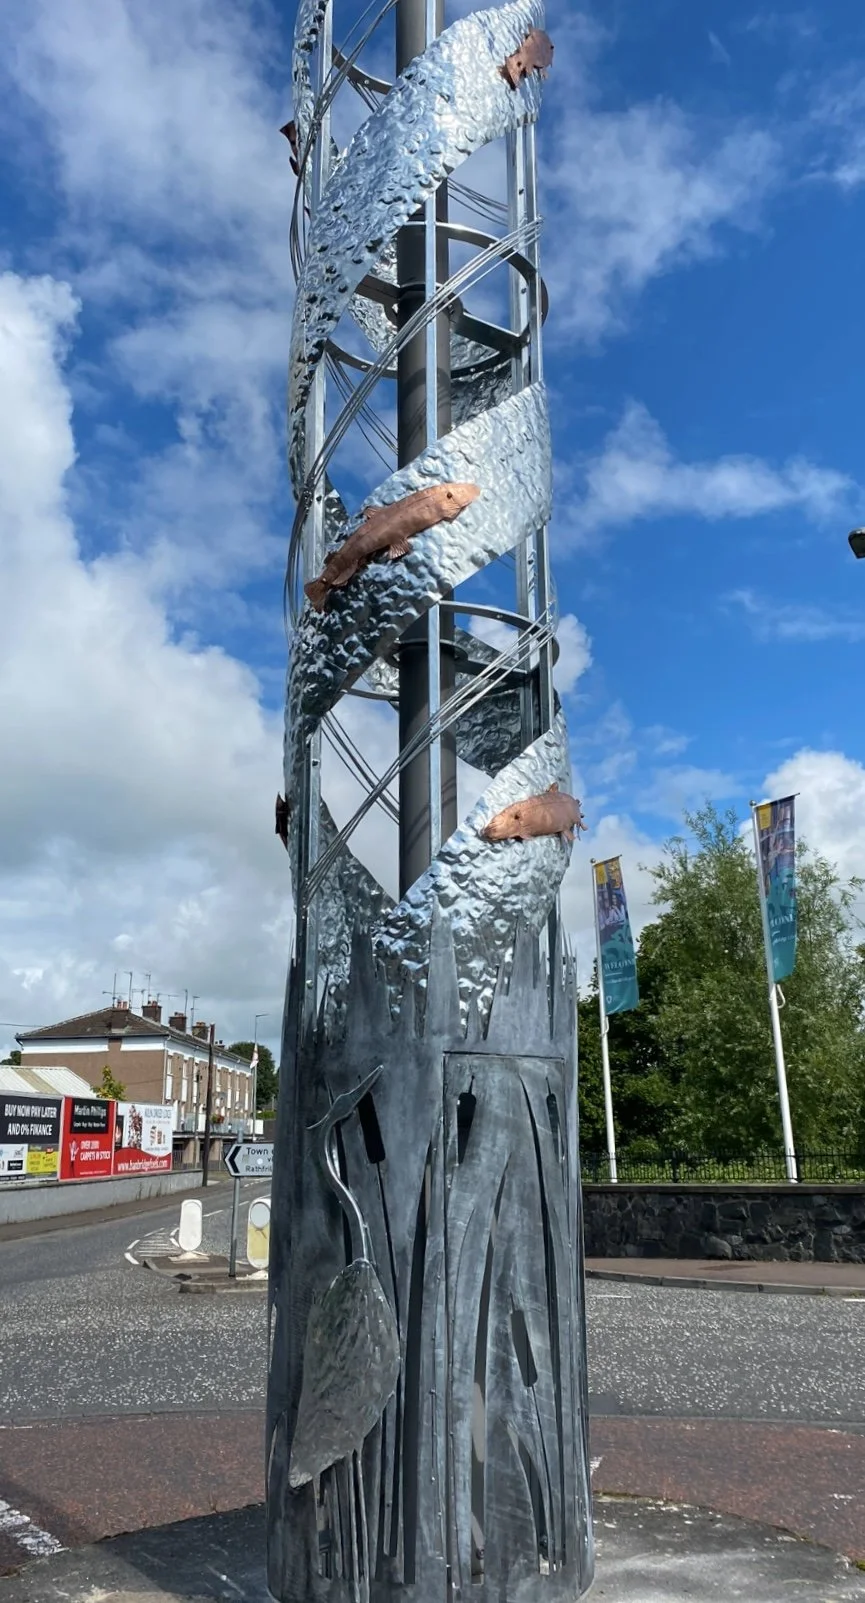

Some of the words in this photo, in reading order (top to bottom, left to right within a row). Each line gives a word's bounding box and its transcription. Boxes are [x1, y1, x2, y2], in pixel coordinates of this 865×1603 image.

[5, 1104, 17, 1117] BUY
[17, 1105, 30, 1117] NOW
[31, 1105, 41, 1118] PAY
[41, 1106, 57, 1118] LATER
[7, 1123, 20, 1135] AND
[20, 1124, 30, 1135] 0%
[30, 1124, 52, 1136] FINANCE
[246, 1147, 268, 1155] Town
